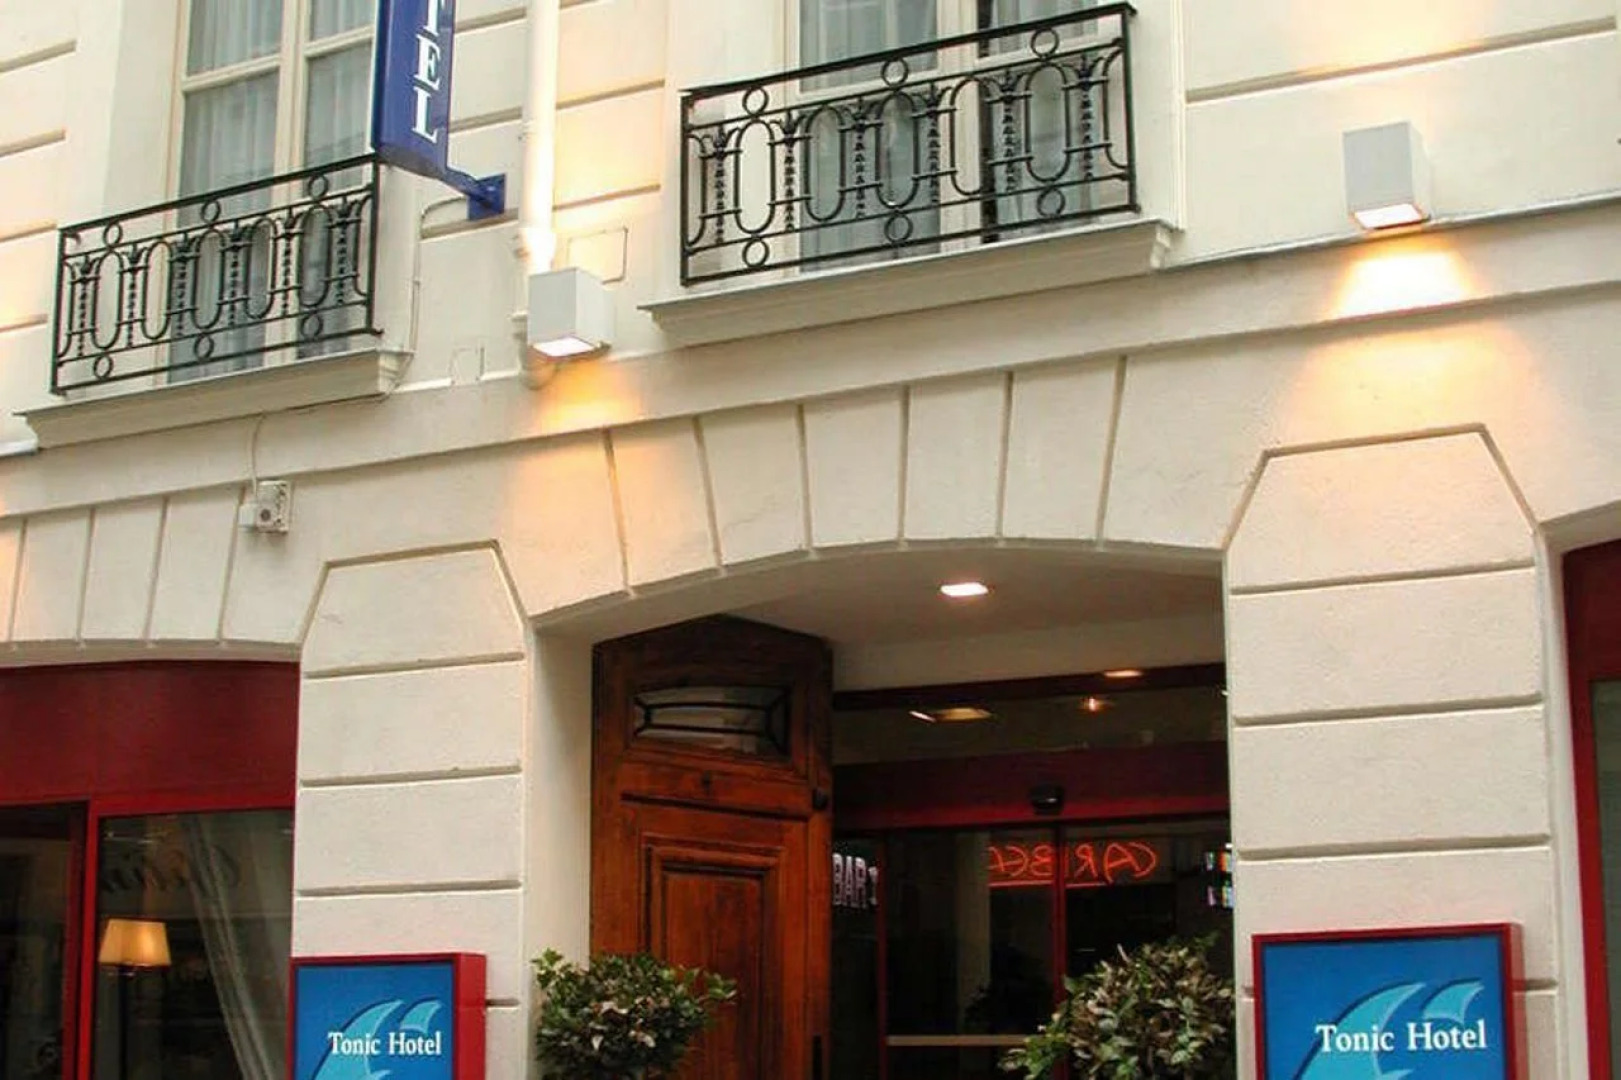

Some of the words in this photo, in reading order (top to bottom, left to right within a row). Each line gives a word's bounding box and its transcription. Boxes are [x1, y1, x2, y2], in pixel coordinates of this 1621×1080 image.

[327, 1031, 381, 1055] Tonic
[388, 1031, 441, 1055] Hotel
[1315, 1024, 1395, 1052] Tonic
[1407, 1019, 1487, 1050] Hotel
